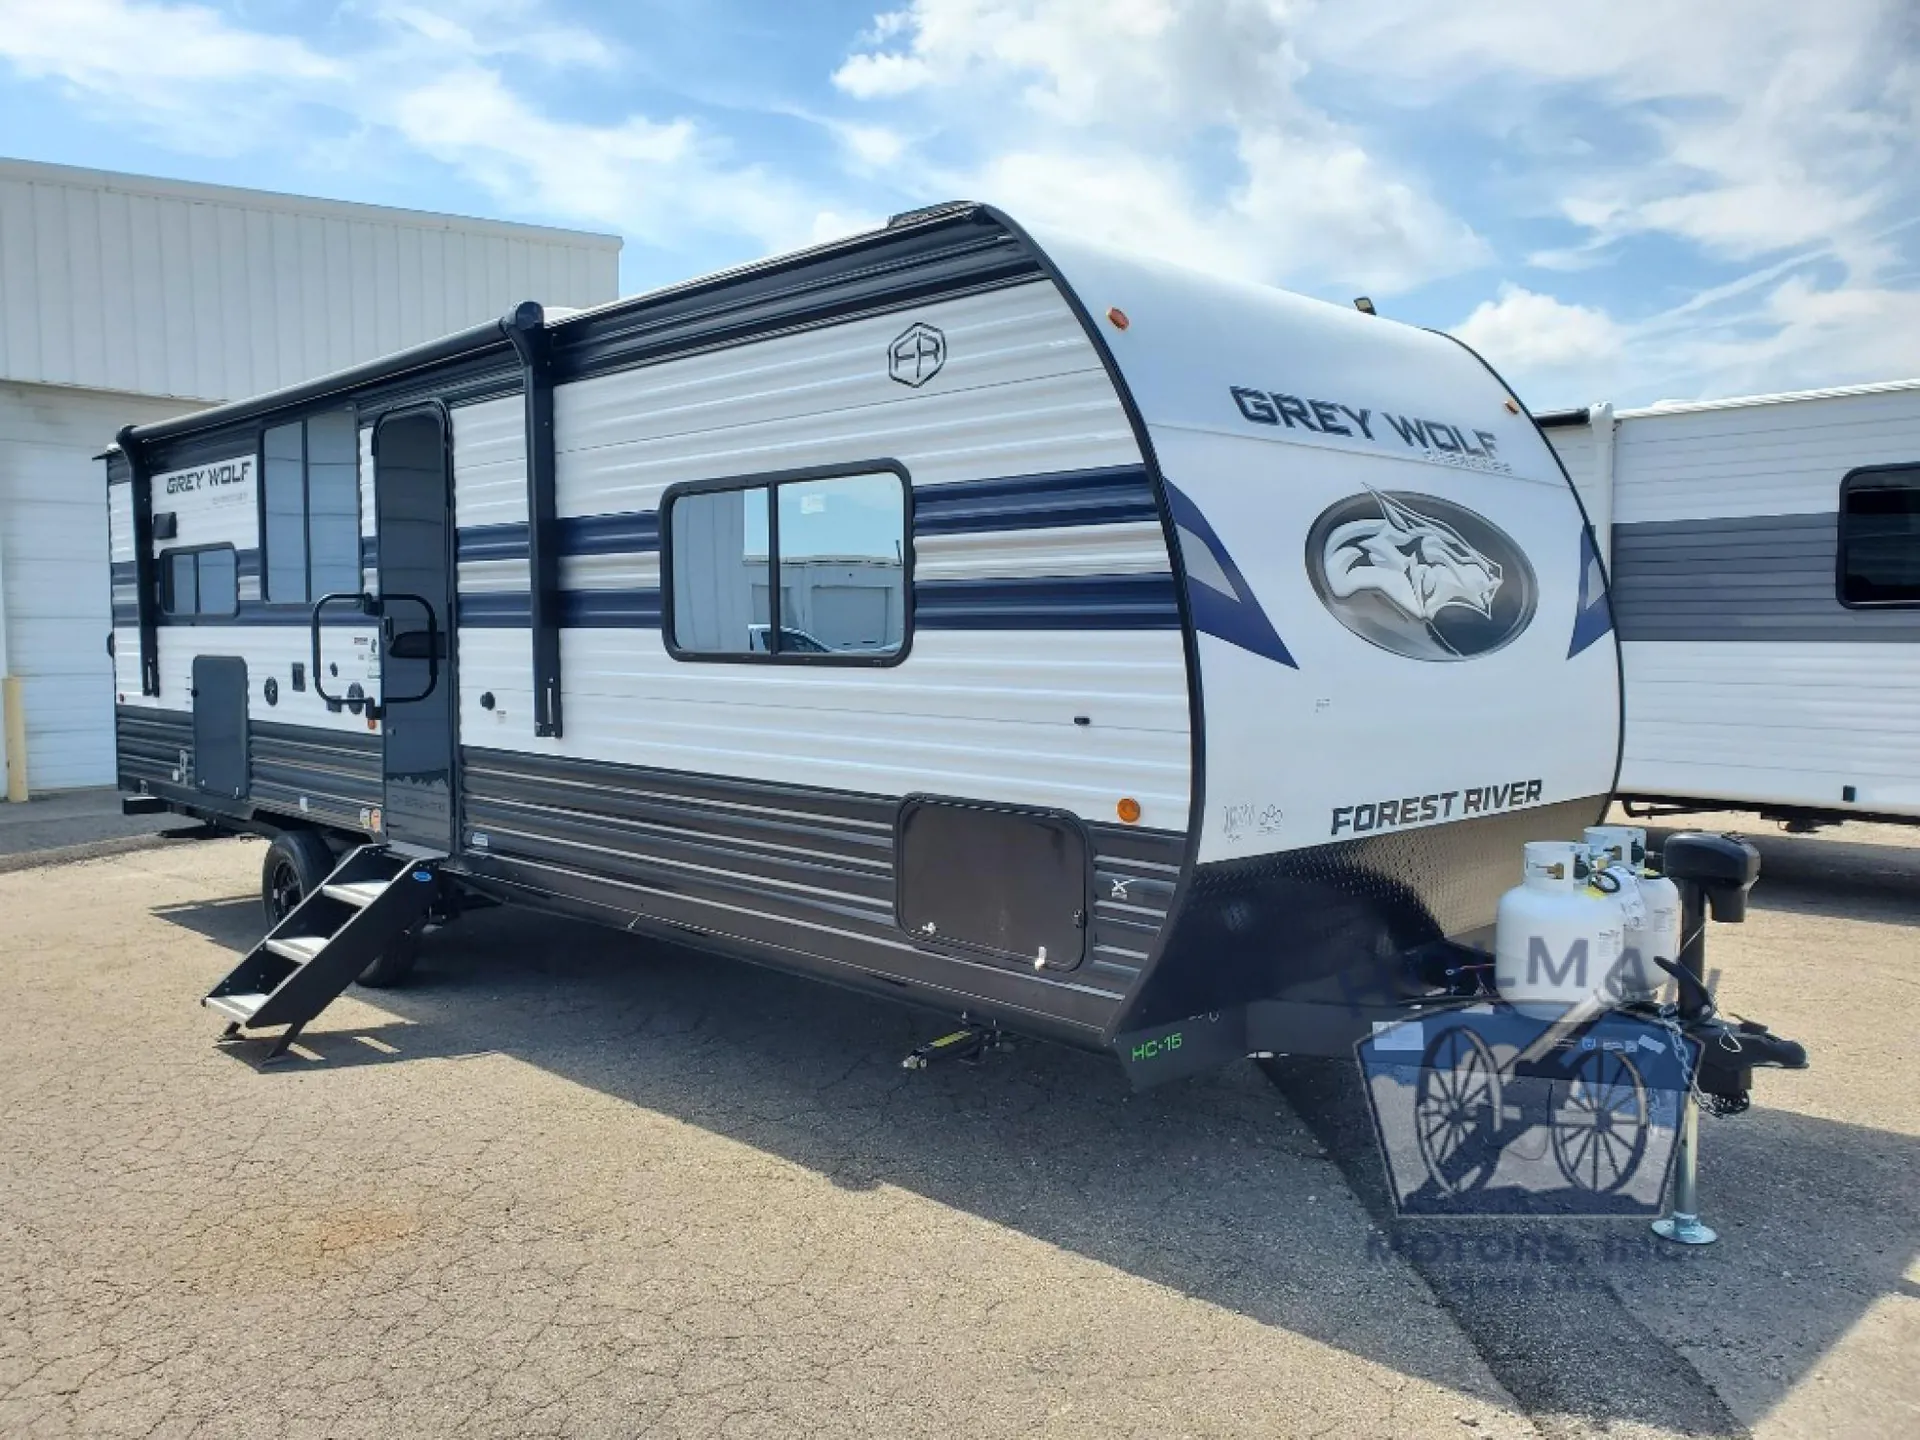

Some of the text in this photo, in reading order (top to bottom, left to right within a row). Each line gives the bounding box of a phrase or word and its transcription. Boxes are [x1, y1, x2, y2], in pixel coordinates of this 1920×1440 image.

[1229, 383, 1498, 459] GREY WOLF
[166, 461, 253, 494] GREY WOLF
[1330, 790, 1460, 836] FOREST
[1463, 778, 1543, 815] RIVER
